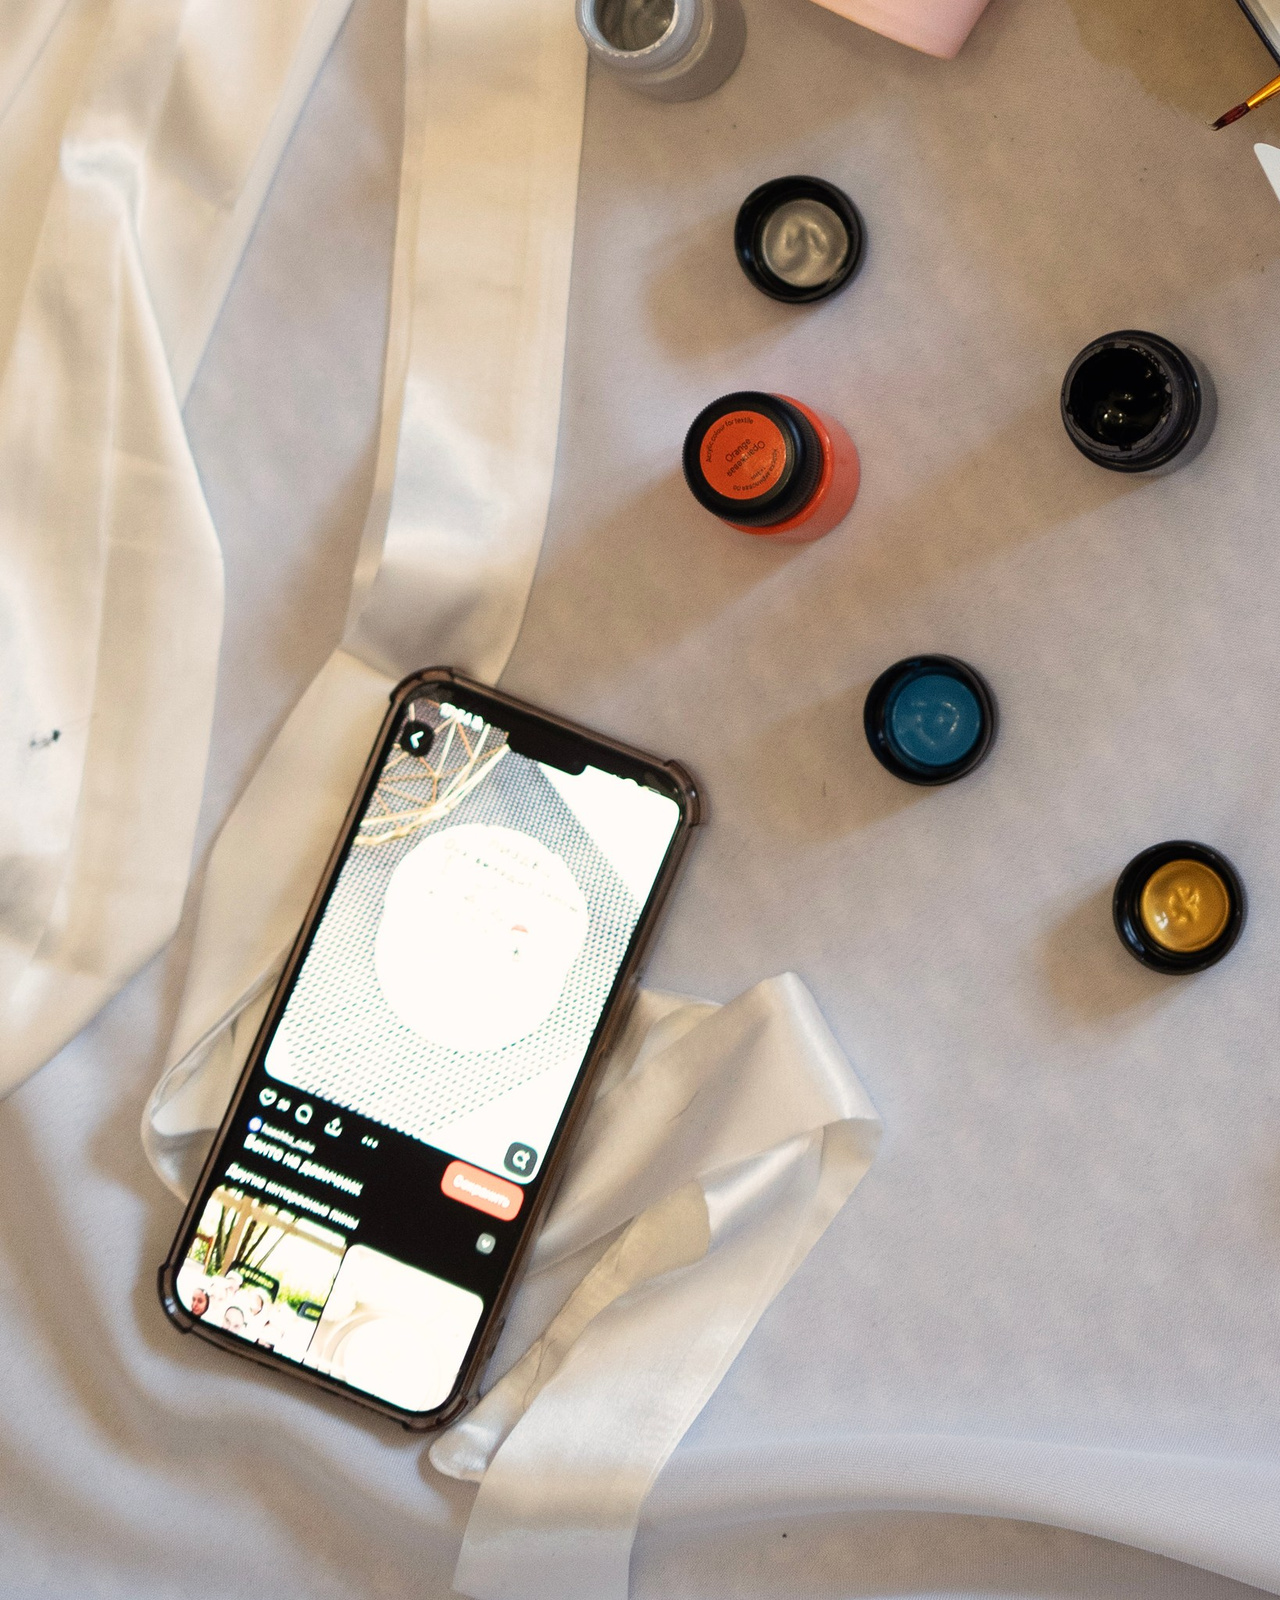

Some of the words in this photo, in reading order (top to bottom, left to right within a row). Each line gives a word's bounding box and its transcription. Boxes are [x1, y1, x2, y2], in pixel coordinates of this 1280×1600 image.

[711, 425, 725, 441] colour
[725, 439, 751, 462] Orange
[727, 441, 765, 477] Оранжевая
